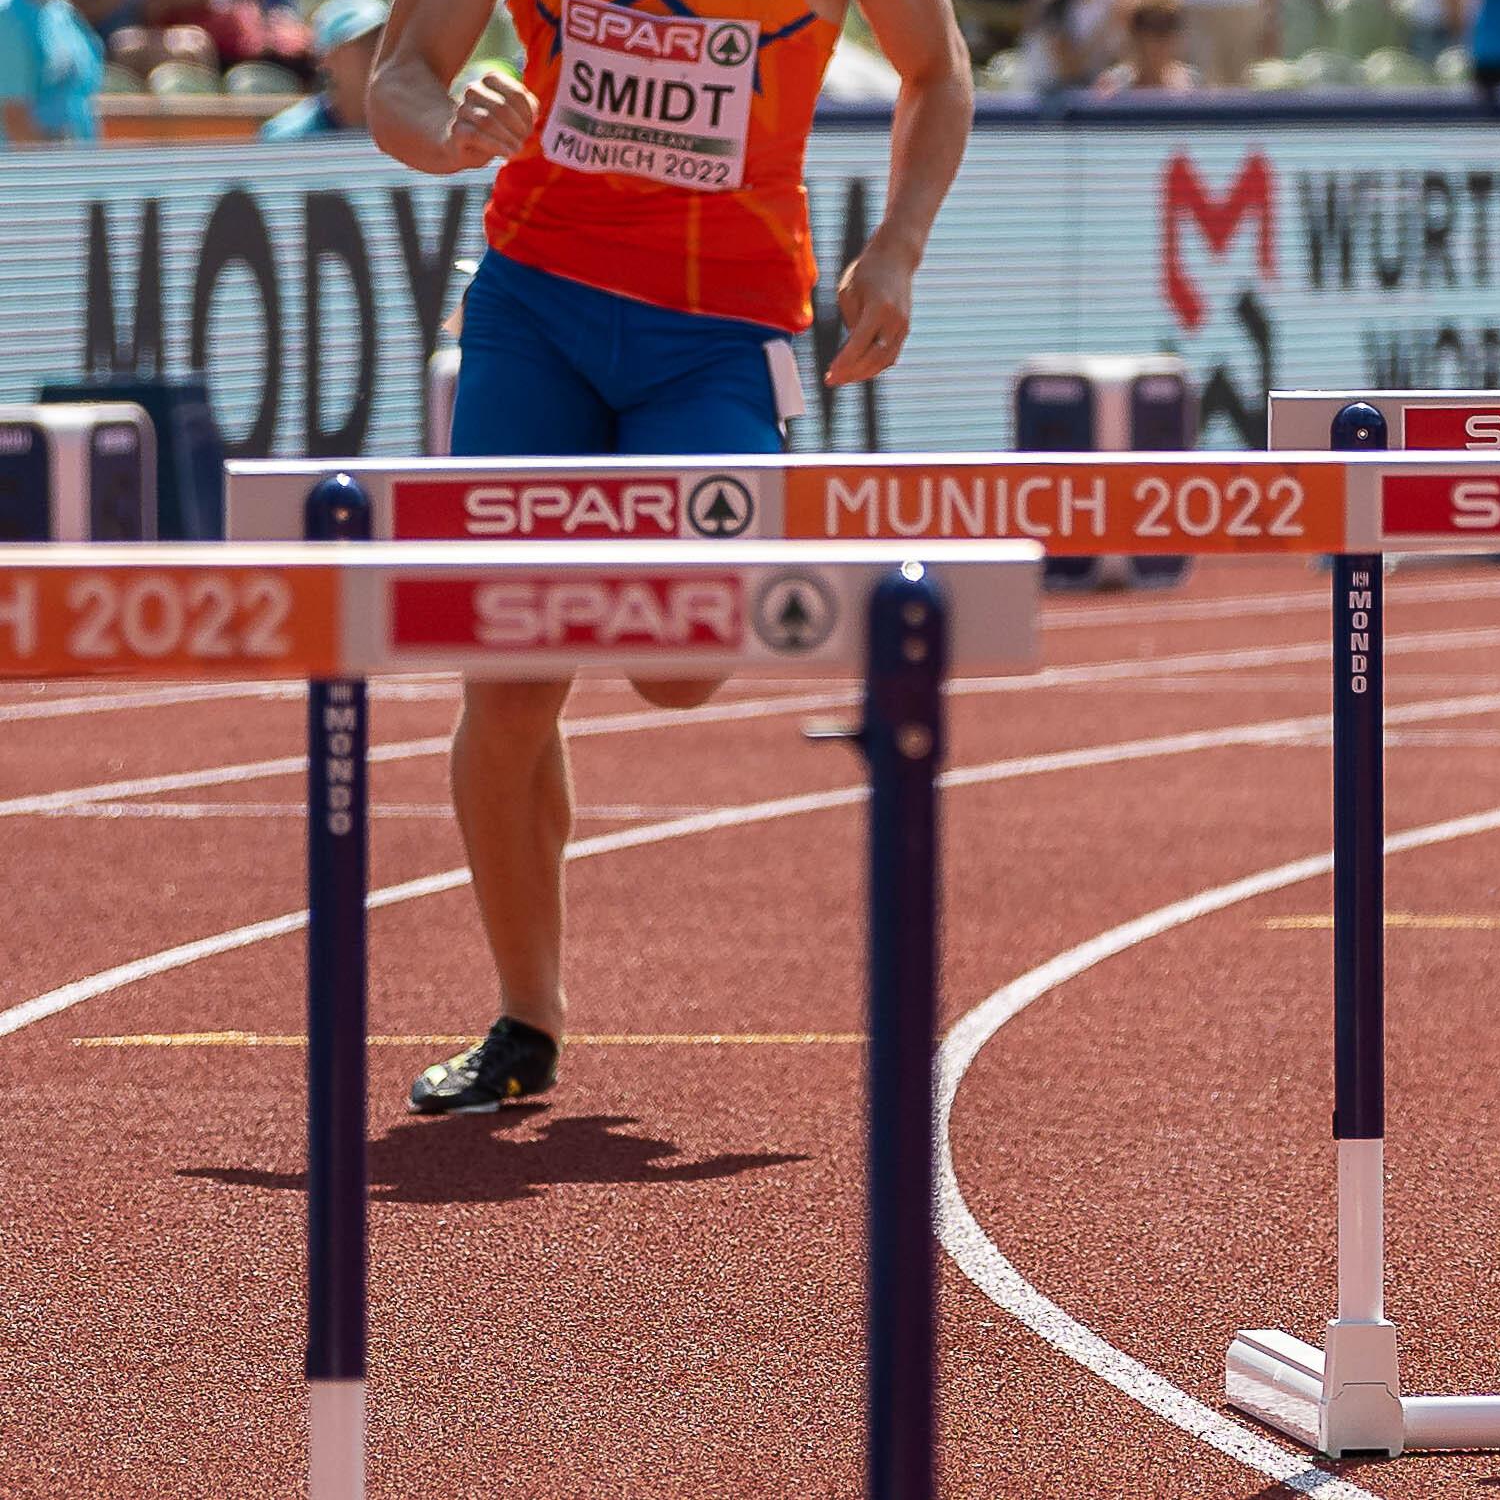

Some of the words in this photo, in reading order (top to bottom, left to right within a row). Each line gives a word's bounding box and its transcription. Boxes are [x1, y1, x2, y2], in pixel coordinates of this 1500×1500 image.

[566, 4, 701, 59] SPAR
[569, 58, 736, 128] SMIDT
[553, 131, 656, 173] MUNICH
[664, 152, 731, 187] 2022
[463, 485, 675, 536] SPAR
[824, 476, 1107, 538] MUNICH
[1133, 476, 1306, 538] 2022
[66, 572, 294, 658] 2022
[470, 582, 738, 650] SPAR
[1348, 590, 1372, 694] MONDO
[322, 706, 358, 836] MONDO
